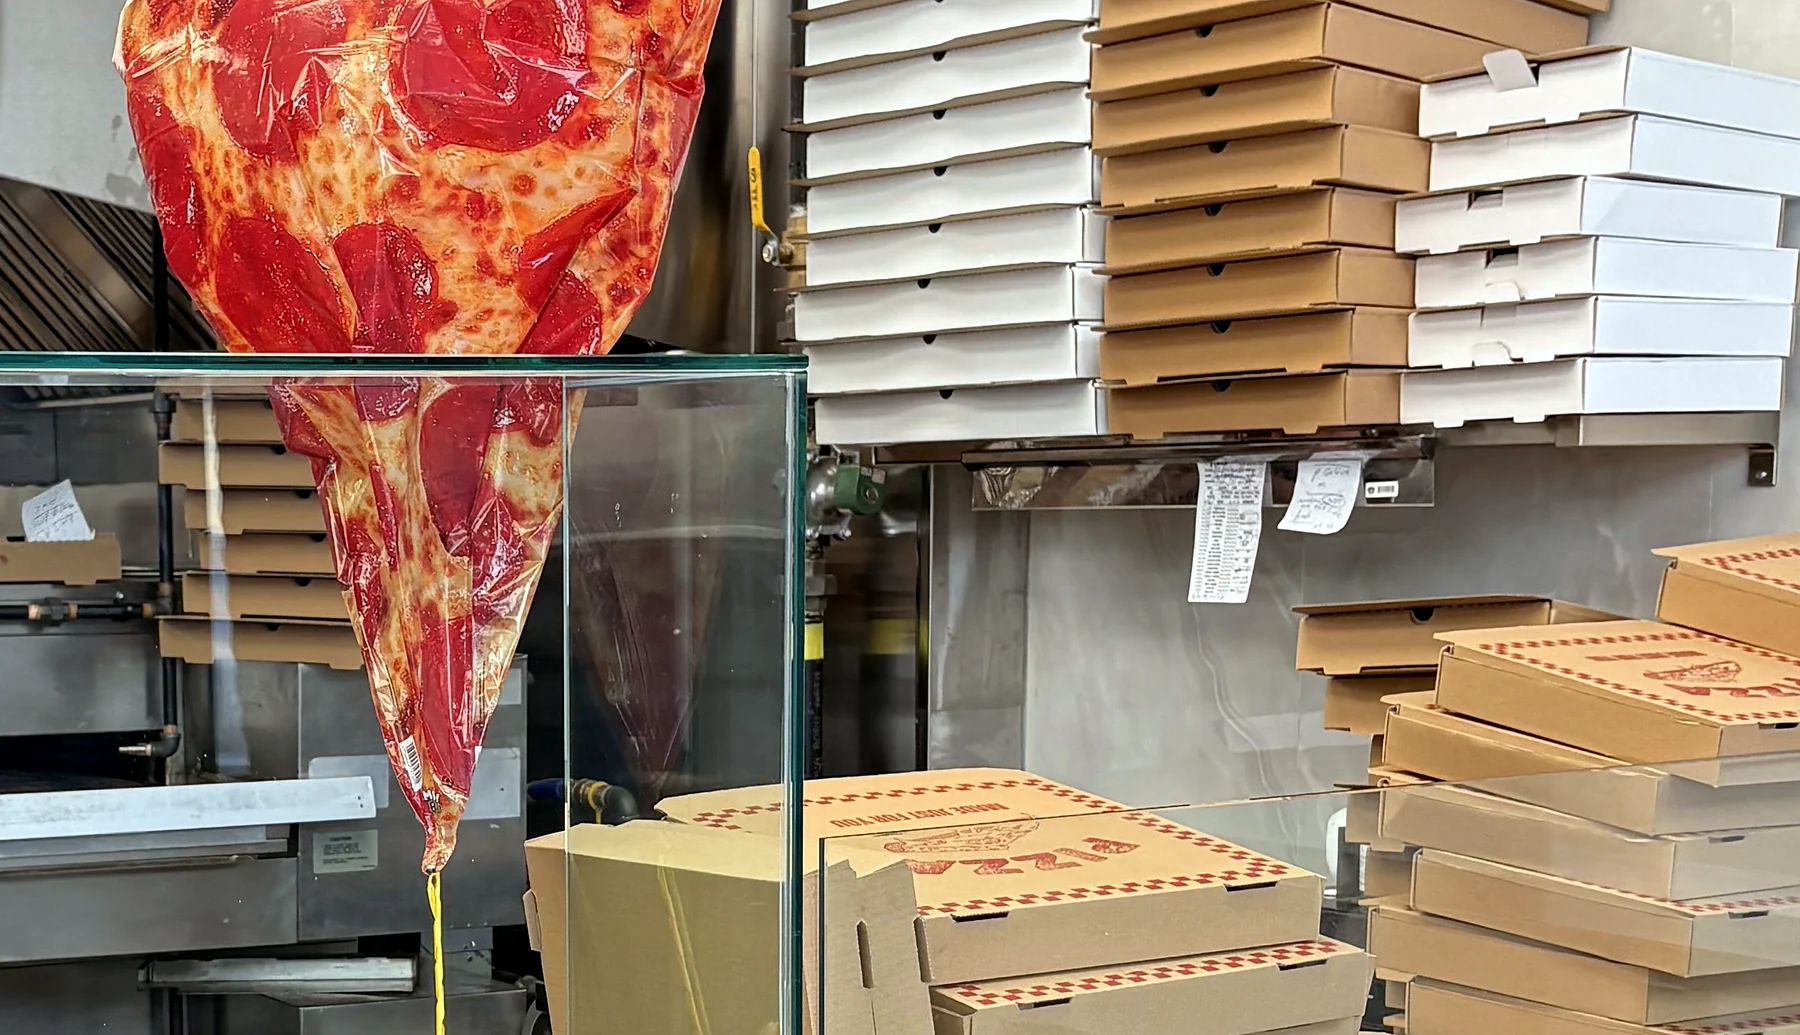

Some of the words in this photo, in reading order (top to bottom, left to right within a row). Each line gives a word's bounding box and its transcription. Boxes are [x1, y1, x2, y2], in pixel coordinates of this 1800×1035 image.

[907, 808, 954, 819] JUST
[948, 802, 1010, 815] MADE
[829, 817, 874, 828] YOU
[868, 812, 912, 823] FOR
[906, 837, 1141, 875] PIZZA
